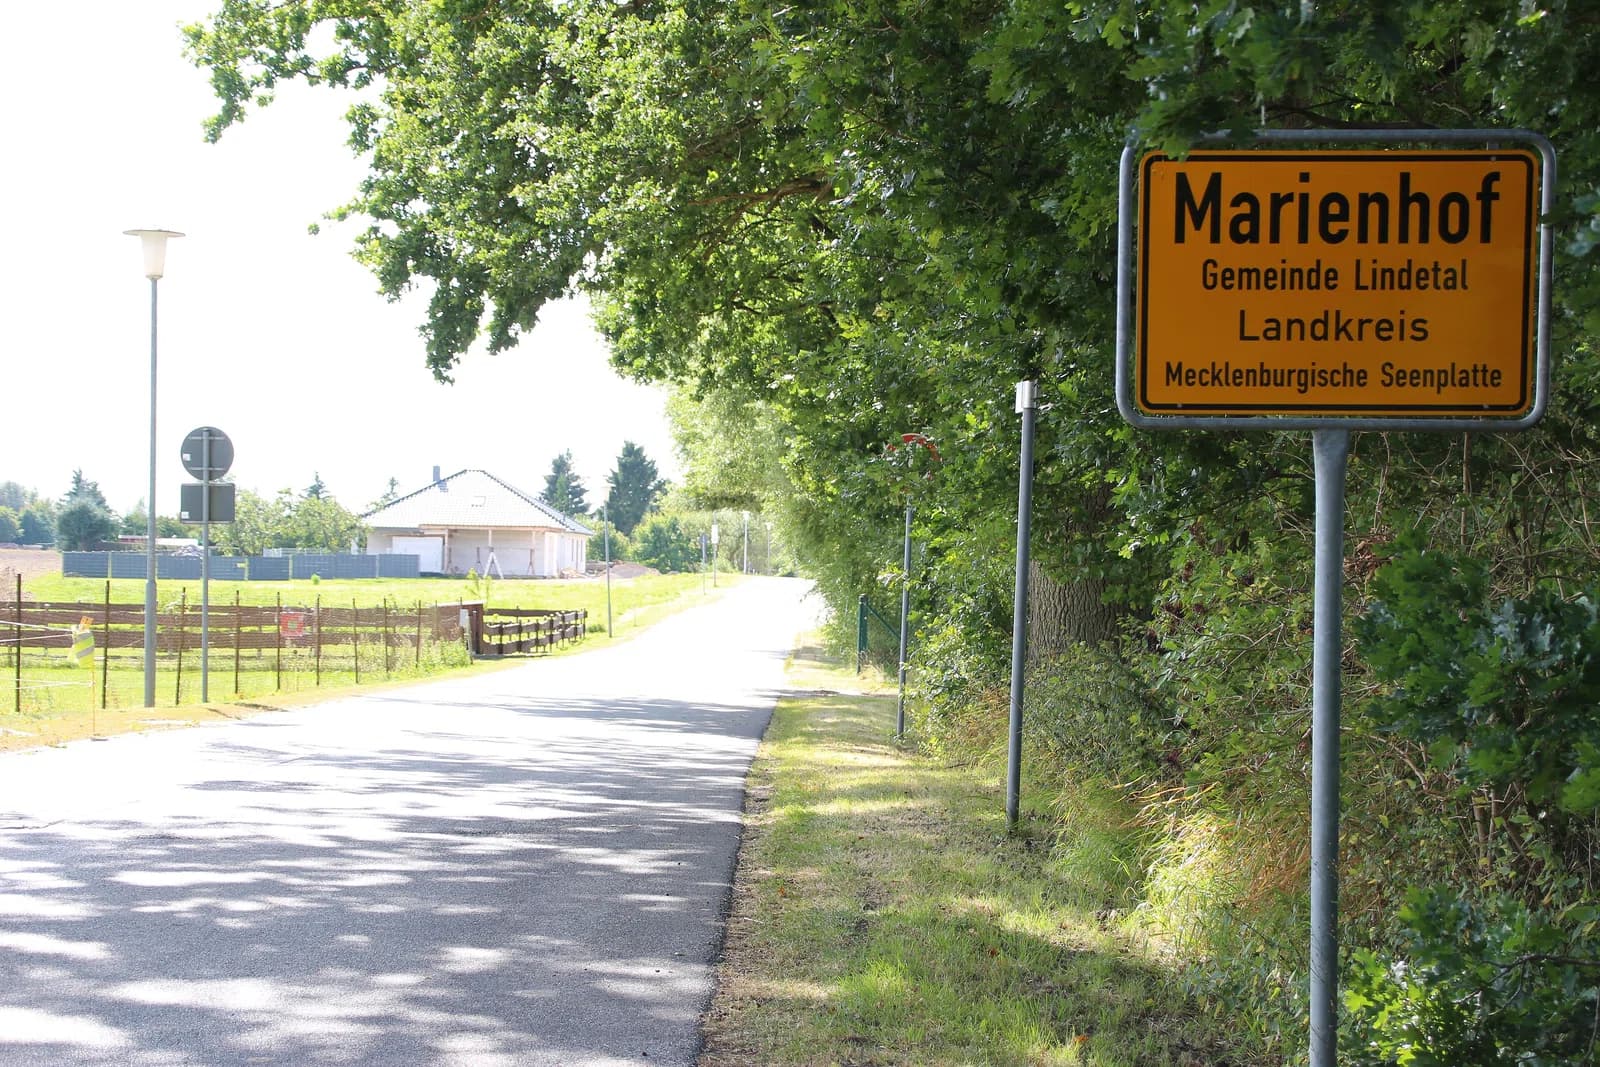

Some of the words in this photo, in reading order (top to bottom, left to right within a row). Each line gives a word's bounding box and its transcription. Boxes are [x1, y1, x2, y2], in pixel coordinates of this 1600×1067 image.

[1174, 171, 1501, 245] Marienhof
[1202, 258, 1339, 291] Gemeinde
[1354, 258, 1469, 291] Lindetal
[1239, 309, 1430, 342] Landkreis
[1165, 361, 1368, 394] Mecklenburgische
[1380, 362, 1502, 394] Seenplatte
